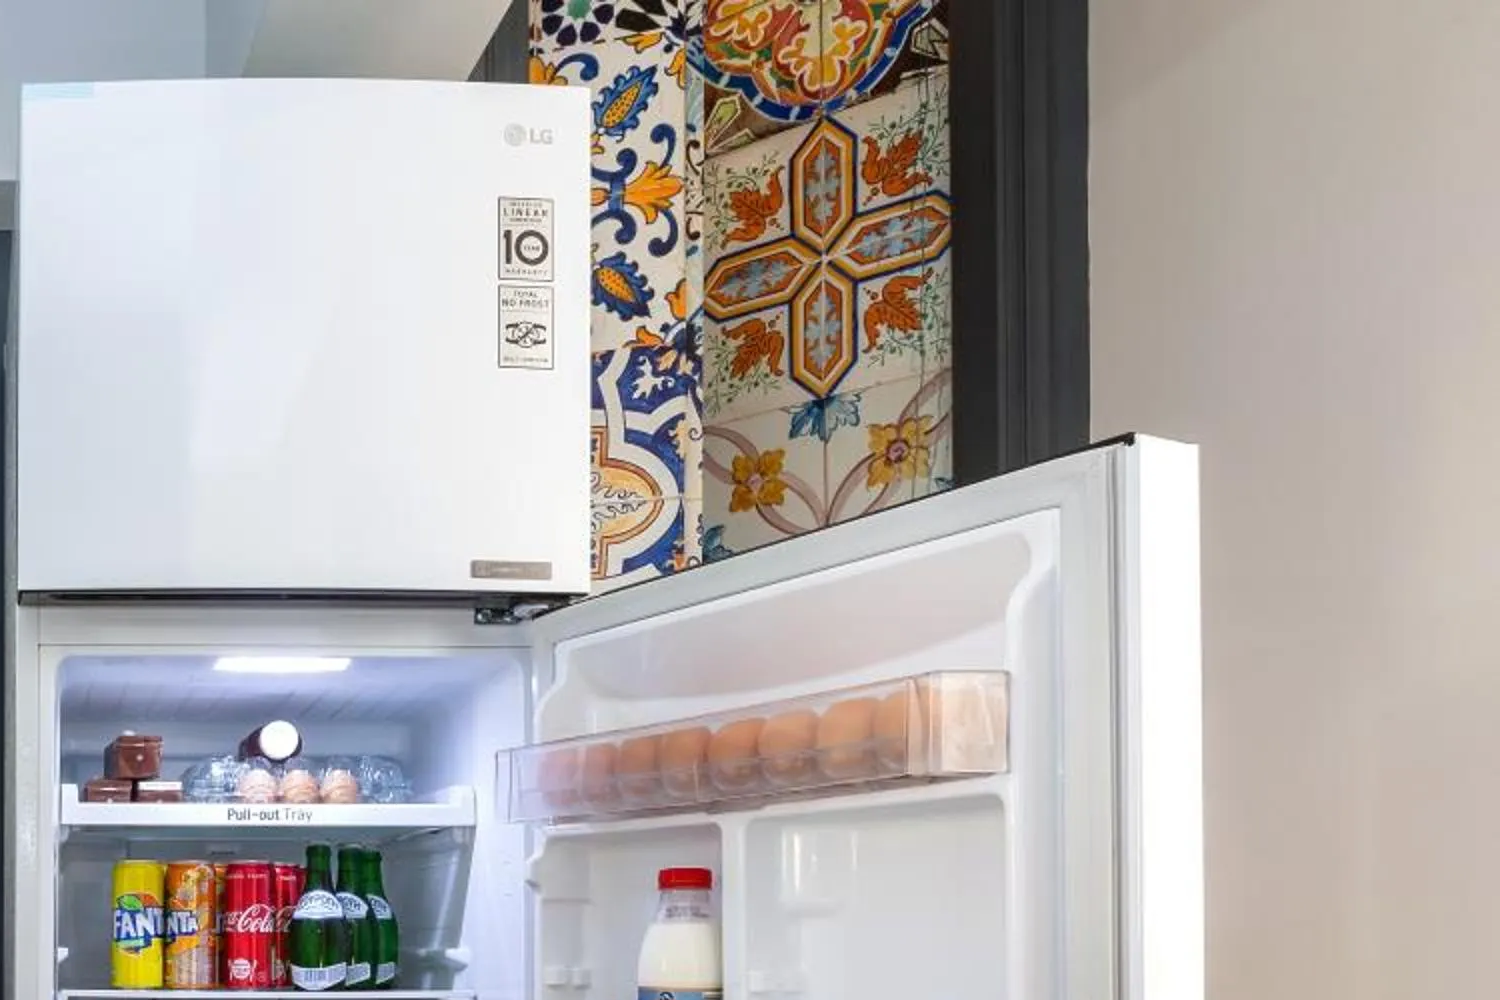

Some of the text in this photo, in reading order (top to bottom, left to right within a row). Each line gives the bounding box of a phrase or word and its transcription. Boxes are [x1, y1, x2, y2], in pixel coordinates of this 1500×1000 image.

[529, 127, 553, 145] LG
[503, 229, 549, 266] 10
[227, 807, 313, 823] Pull-out Tray
[113, 907, 163, 939] FANT
